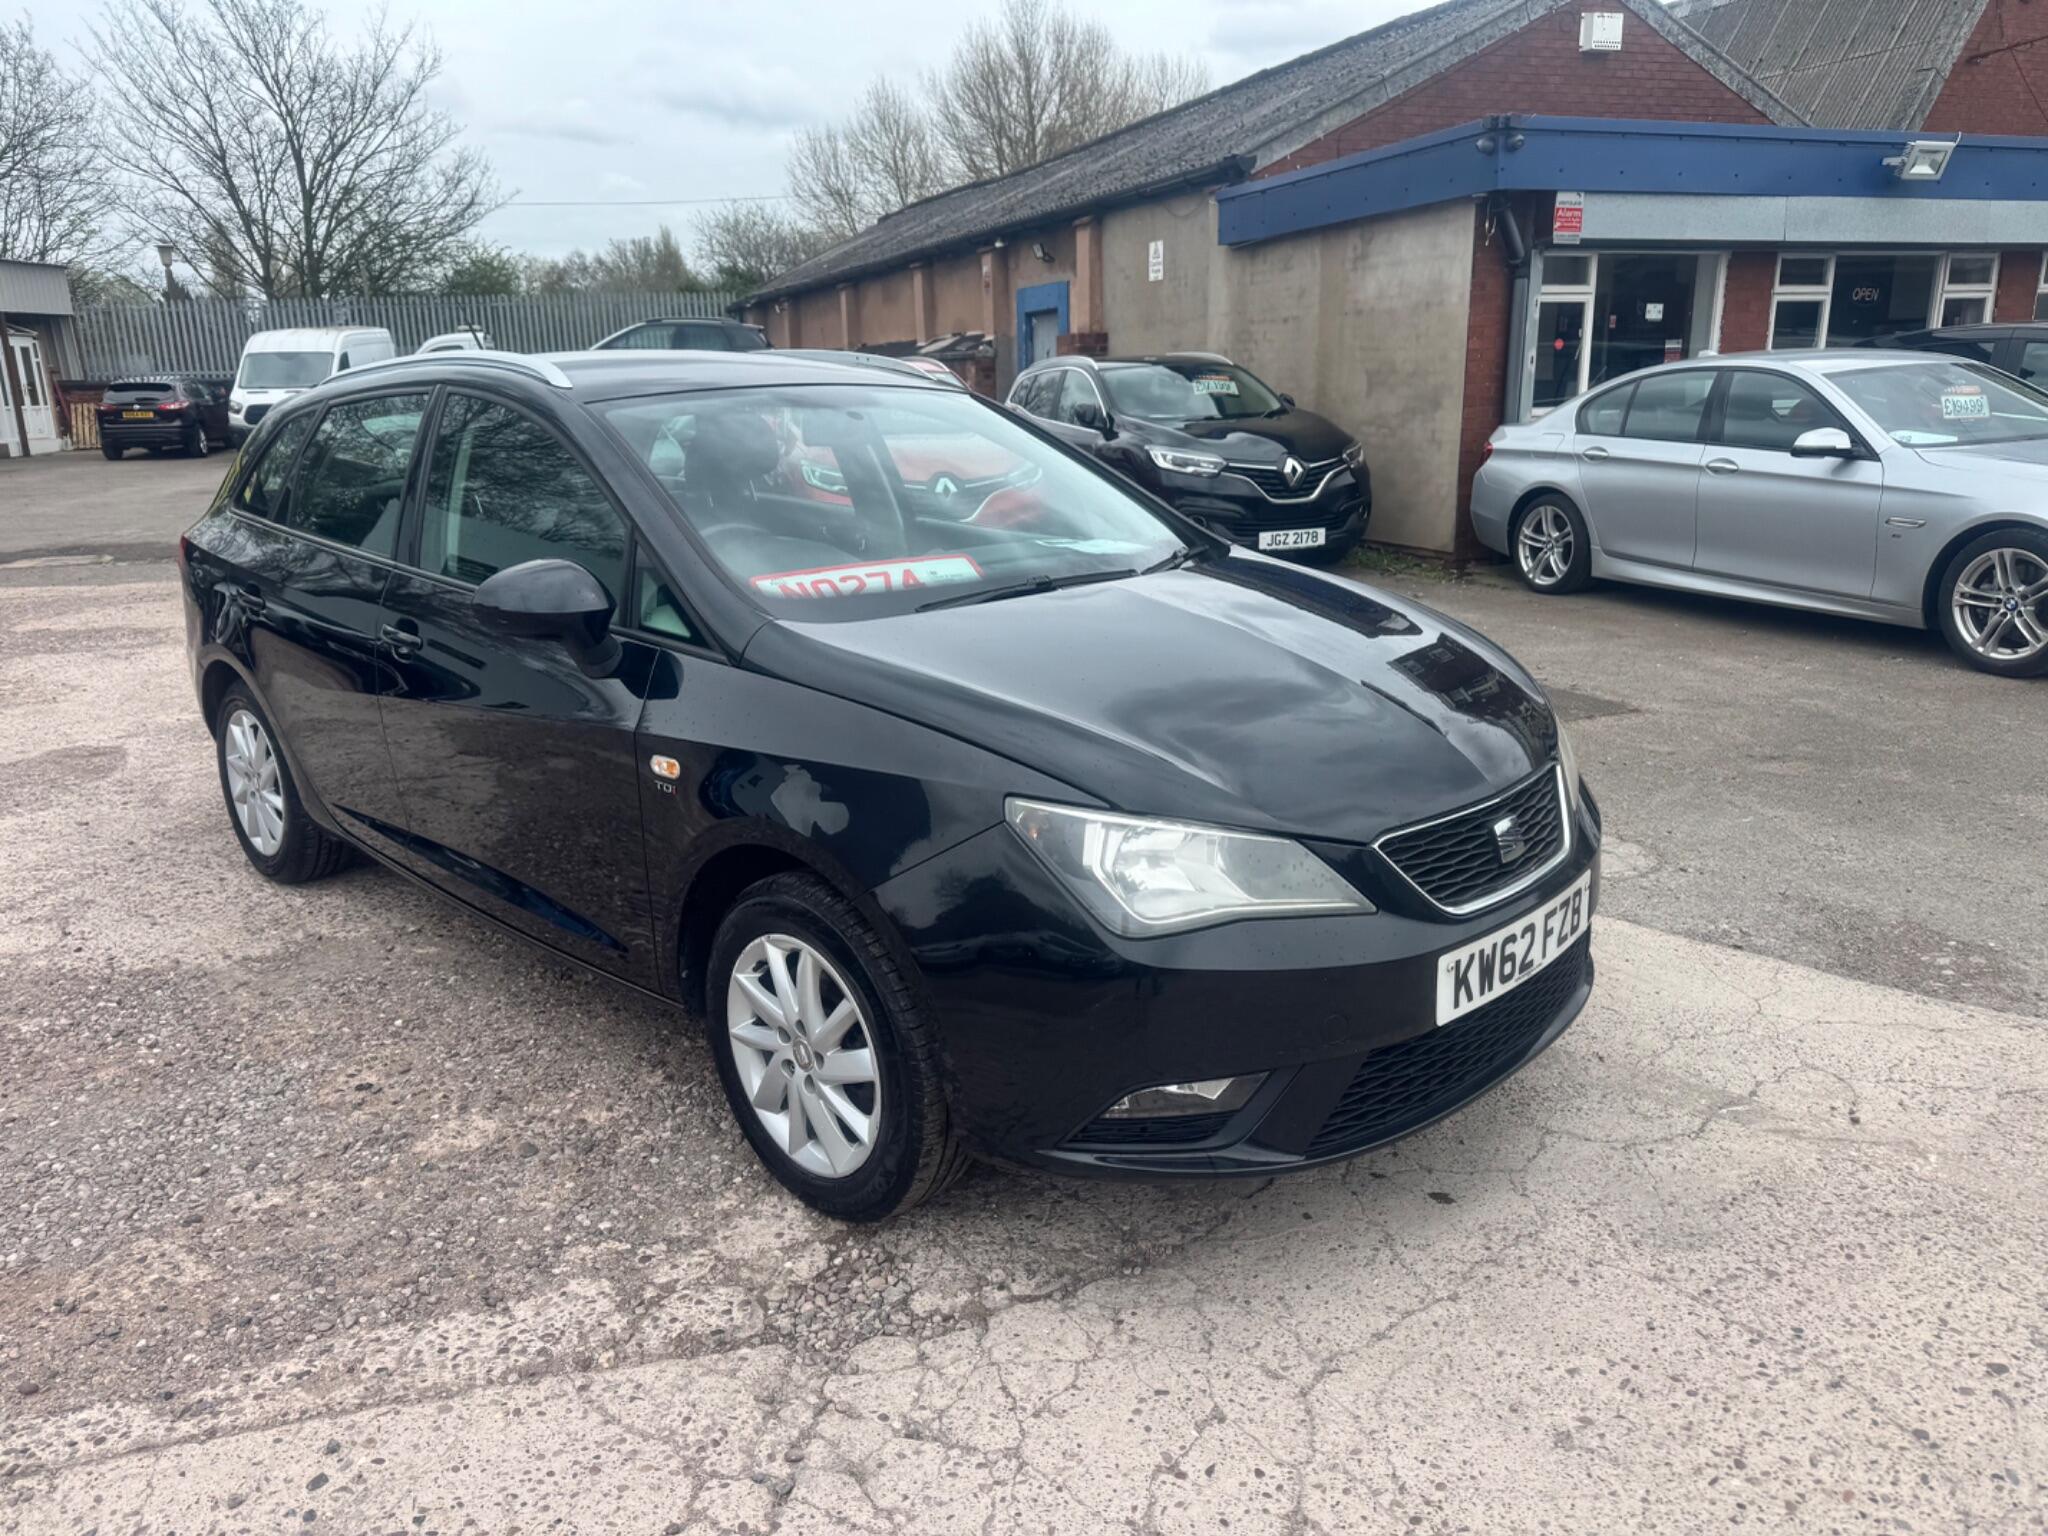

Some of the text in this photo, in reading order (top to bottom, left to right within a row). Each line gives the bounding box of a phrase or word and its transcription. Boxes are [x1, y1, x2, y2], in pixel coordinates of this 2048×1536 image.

[1557, 208, 1582, 218] Alarm
[1853, 288, 1880, 301] OPEN
[1266, 530, 1319, 547] JGZ 2178
[1453, 887, 1583, 1010] KW62 FZB
